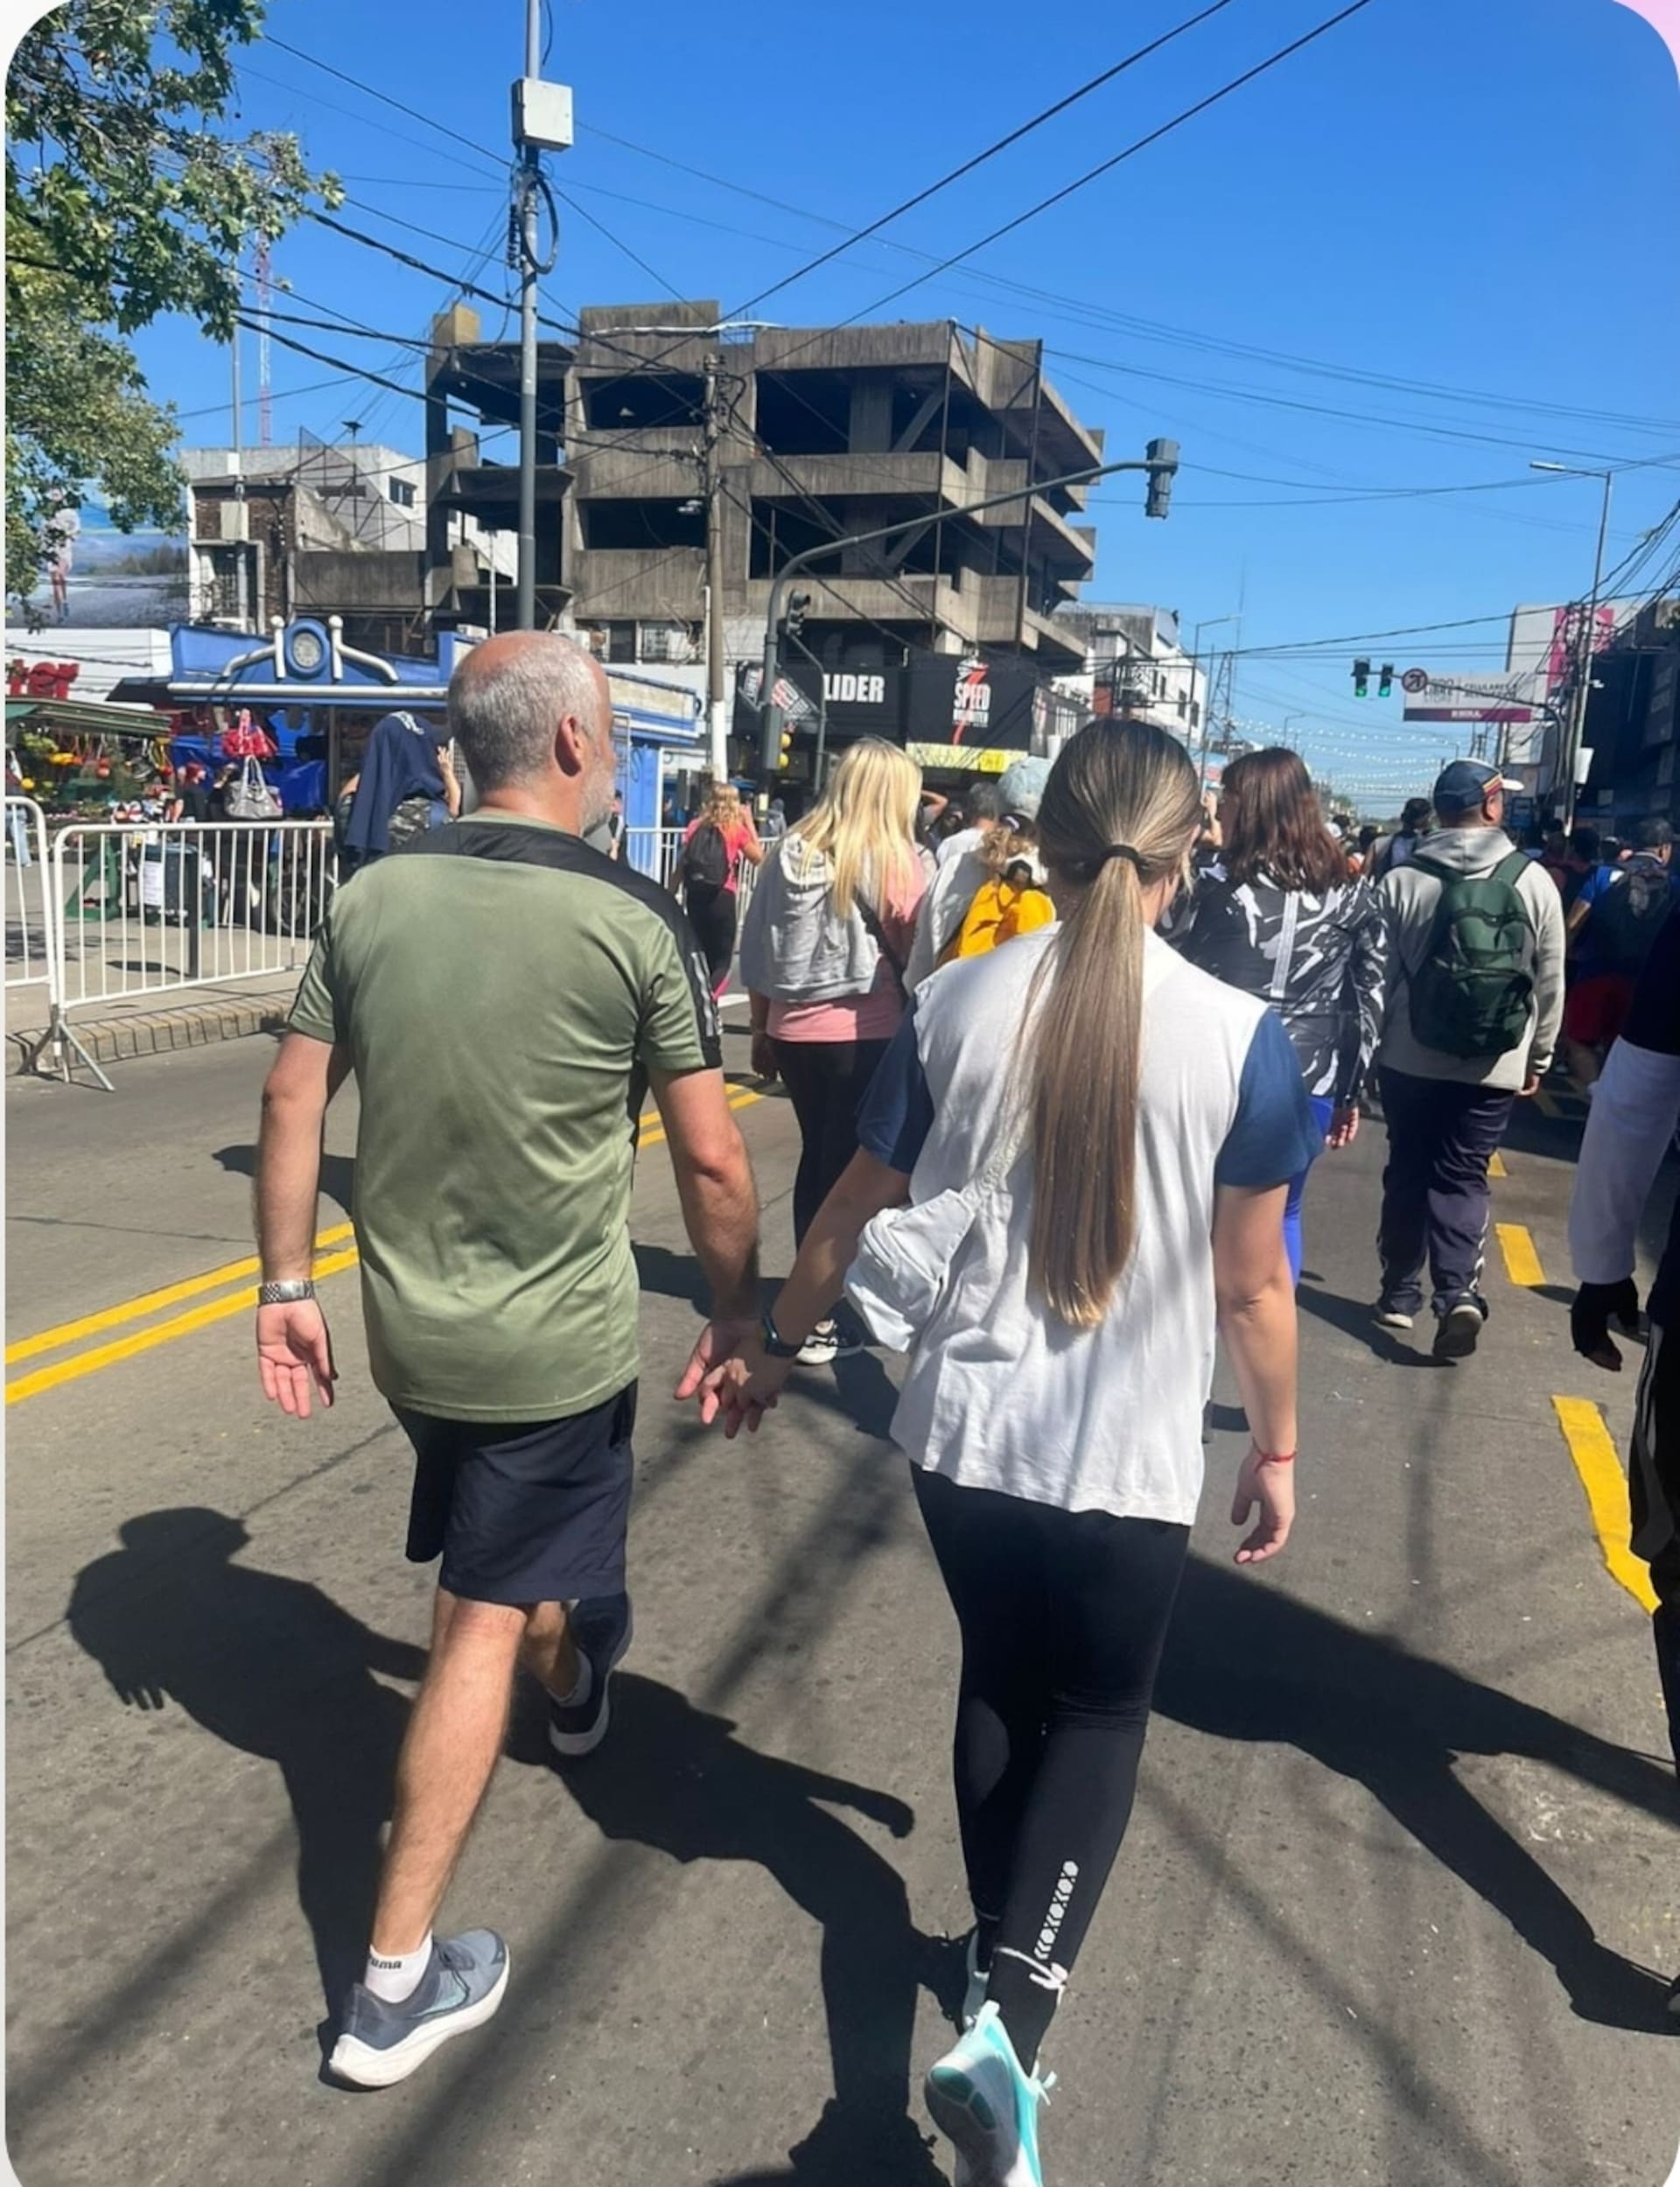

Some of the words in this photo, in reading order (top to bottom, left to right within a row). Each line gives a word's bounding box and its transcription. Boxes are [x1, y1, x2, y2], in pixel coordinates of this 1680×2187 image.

[822, 673, 885, 703] LIDER
[954, 682, 990, 711] SPEED
[370, 1959, 402, 1969] uma
